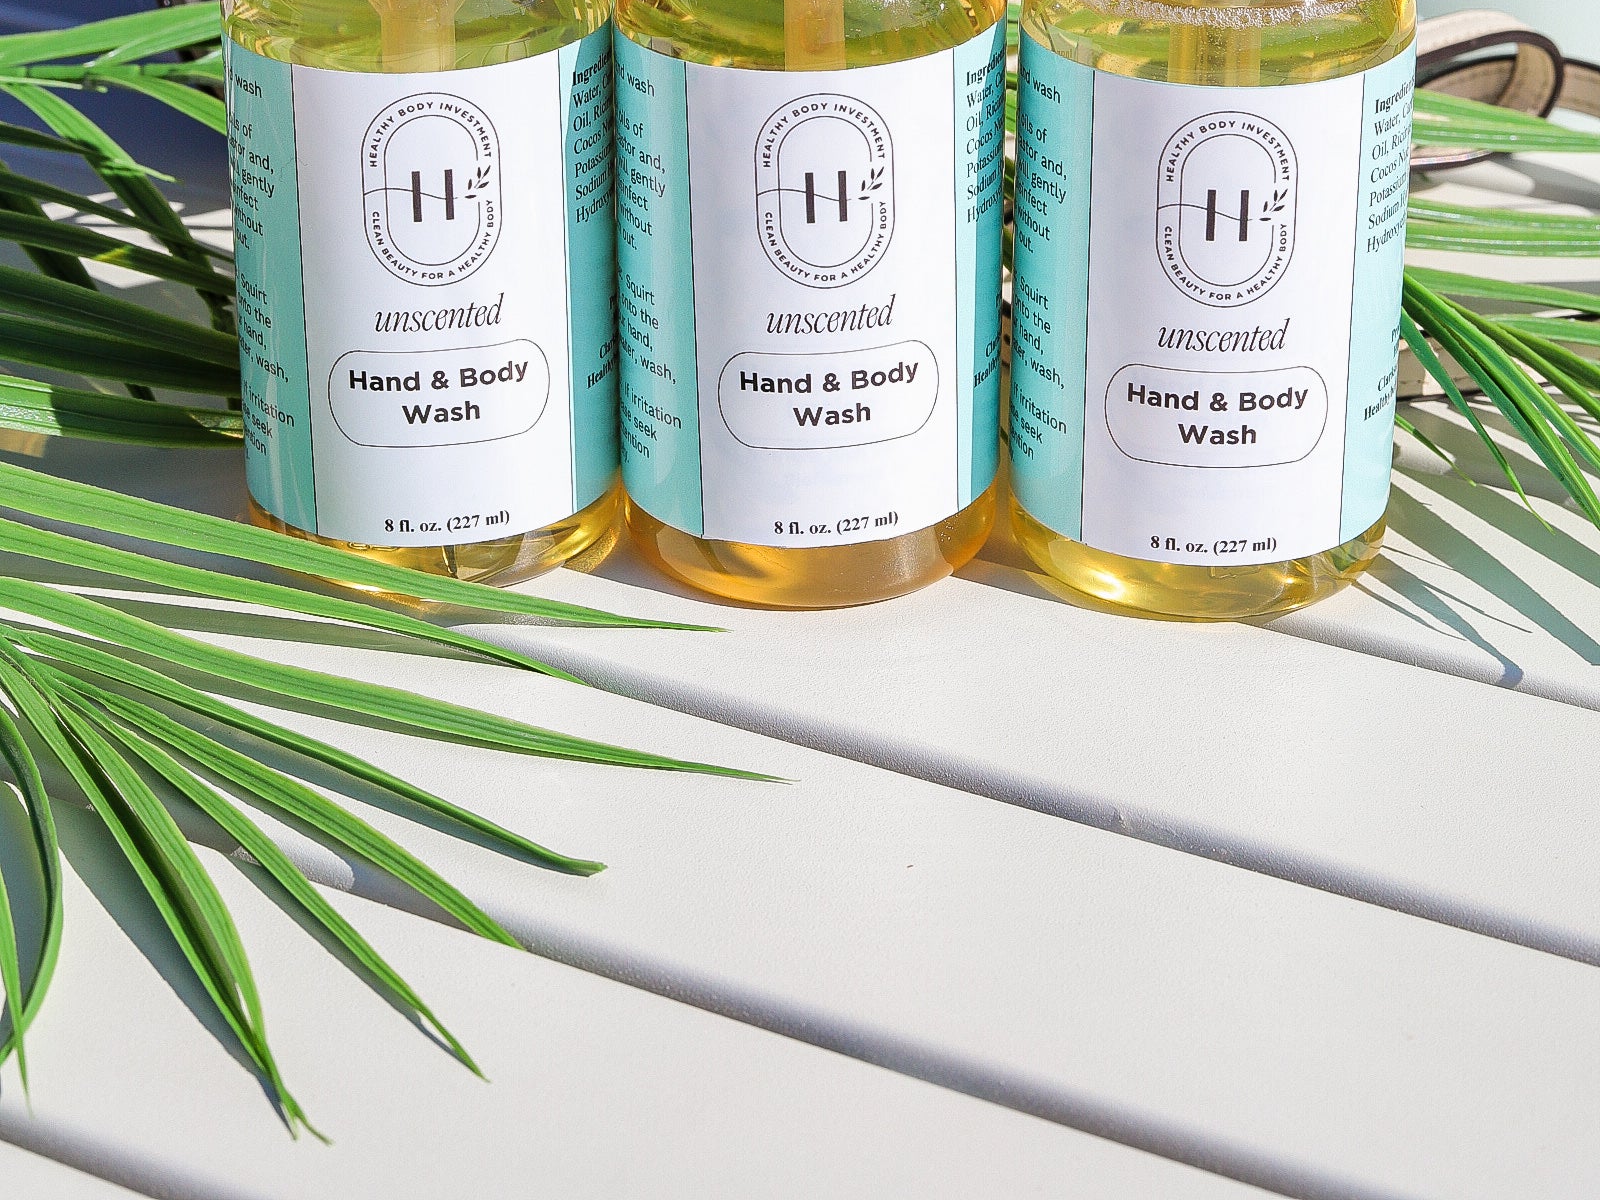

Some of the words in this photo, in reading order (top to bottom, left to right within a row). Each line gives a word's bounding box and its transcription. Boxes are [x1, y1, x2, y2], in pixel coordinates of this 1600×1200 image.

[235, 73, 262, 98] wash
[573, 84, 601, 108] Water,
[627, 71, 655, 97] wash
[967, 83, 993, 108] Water,
[1033, 76, 1061, 104] wash
[242, 123, 252, 140] of
[369, 116, 394, 168] HEALTHY
[398, 102, 433, 116] BODY
[440, 102, 491, 157] INVESTMENT
[573, 111, 591, 131] Oil,
[633, 123, 643, 138] of
[763, 116, 788, 167] HEALTHY
[792, 102, 828, 117] BODY
[834, 104, 885, 158] INVESTMENT
[966, 111, 983, 131] Oil,
[1036, 128, 1047, 143] of
[1374, 114, 1400, 136] Water,
[574, 129, 601, 154] Cocos
[617, 133, 635, 157] astor
[639, 150, 665, 174] and,
[967, 128, 992, 154] Cocos
[1166, 132, 1195, 182] HEALTHY
[1199, 121, 1236, 133] BODY
[1242, 122, 1289, 180] INVESTMENT
[1372, 140, 1388, 160] Oil,
[249, 151, 274, 174] and,
[1019, 133, 1038, 161] astor
[1041, 155, 1067, 180] and,
[1371, 159, 1397, 183] Cocos
[242, 169, 275, 198] gently
[576, 171, 606, 200] Sodium
[631, 168, 665, 197] gently
[967, 169, 996, 200] Sodium
[1031, 172, 1067, 203] gently
[1369, 201, 1399, 230] Sodium
[372, 211, 384, 245] CLEAN
[382, 248, 418, 276] BEAUTY
[458, 232, 491, 272] HEALTHY
[486, 200, 494, 228] BODY
[765, 212, 777, 246] CLEAN
[774, 249, 810, 278] BEAUTY
[851, 234, 884, 274] HEALTHY
[1165, 226, 1174, 261] CLEAN
[1171, 264, 1205, 295] BEAUTY
[1247, 256, 1282, 294] HEALTHY
[241, 273, 267, 305] Squirt
[626, 274, 656, 306] Squirt
[1020, 275, 1049, 310] Squirt
[254, 306, 272, 328] the
[374, 292, 505, 333] unscented
[640, 307, 659, 330] the
[766, 295, 897, 335] unscented
[1033, 311, 1051, 334] the
[244, 317, 266, 350] hand,
[628, 318, 653, 352] hand,
[1020, 319, 1044, 354] hand,
[1156, 317, 1290, 353] unscented
[256, 353, 289, 383] wash,
[621, 334, 637, 363] ater,
[640, 354, 676, 384] wash,
[1030, 357, 1064, 389] wash,
[348, 368, 422, 393] Hand
[432, 370, 449, 391] &
[459, 359, 529, 388] Body
[739, 371, 812, 394] Hand
[822, 372, 840, 393] &
[851, 360, 919, 390] Body
[249, 386, 295, 427] irritation
[631, 388, 682, 430] irritation
[1020, 389, 1067, 435] irritation
[1127, 383, 1200, 411] Hand
[1212, 391, 1228, 412] &
[1239, 384, 1309, 411] Body
[252, 414, 273, 439] seek
[402, 401, 481, 425] Wash
[793, 403, 871, 427] Wash
[634, 416, 657, 441] seek
[1021, 416, 1043, 444] seek
[1178, 424, 1257, 445] Wash
[385, 519, 394, 532] 8
[400, 519, 414, 532] fl.
[420, 522, 441, 532] oz.
[447, 514, 479, 532] (227
[486, 511, 509, 526] ml)
[775, 521, 783, 534] 8
[788, 522, 804, 535] fl.
[809, 524, 831, 534] oz.
[836, 517, 868, 535] (227
[875, 511, 898, 527] ml)
[1151, 535, 1160, 548] 8
[1166, 537, 1181, 552] fl.
[1186, 542, 1207, 552] oz.
[1214, 539, 1246, 556] (227
[1252, 537, 1277, 552] ml)
